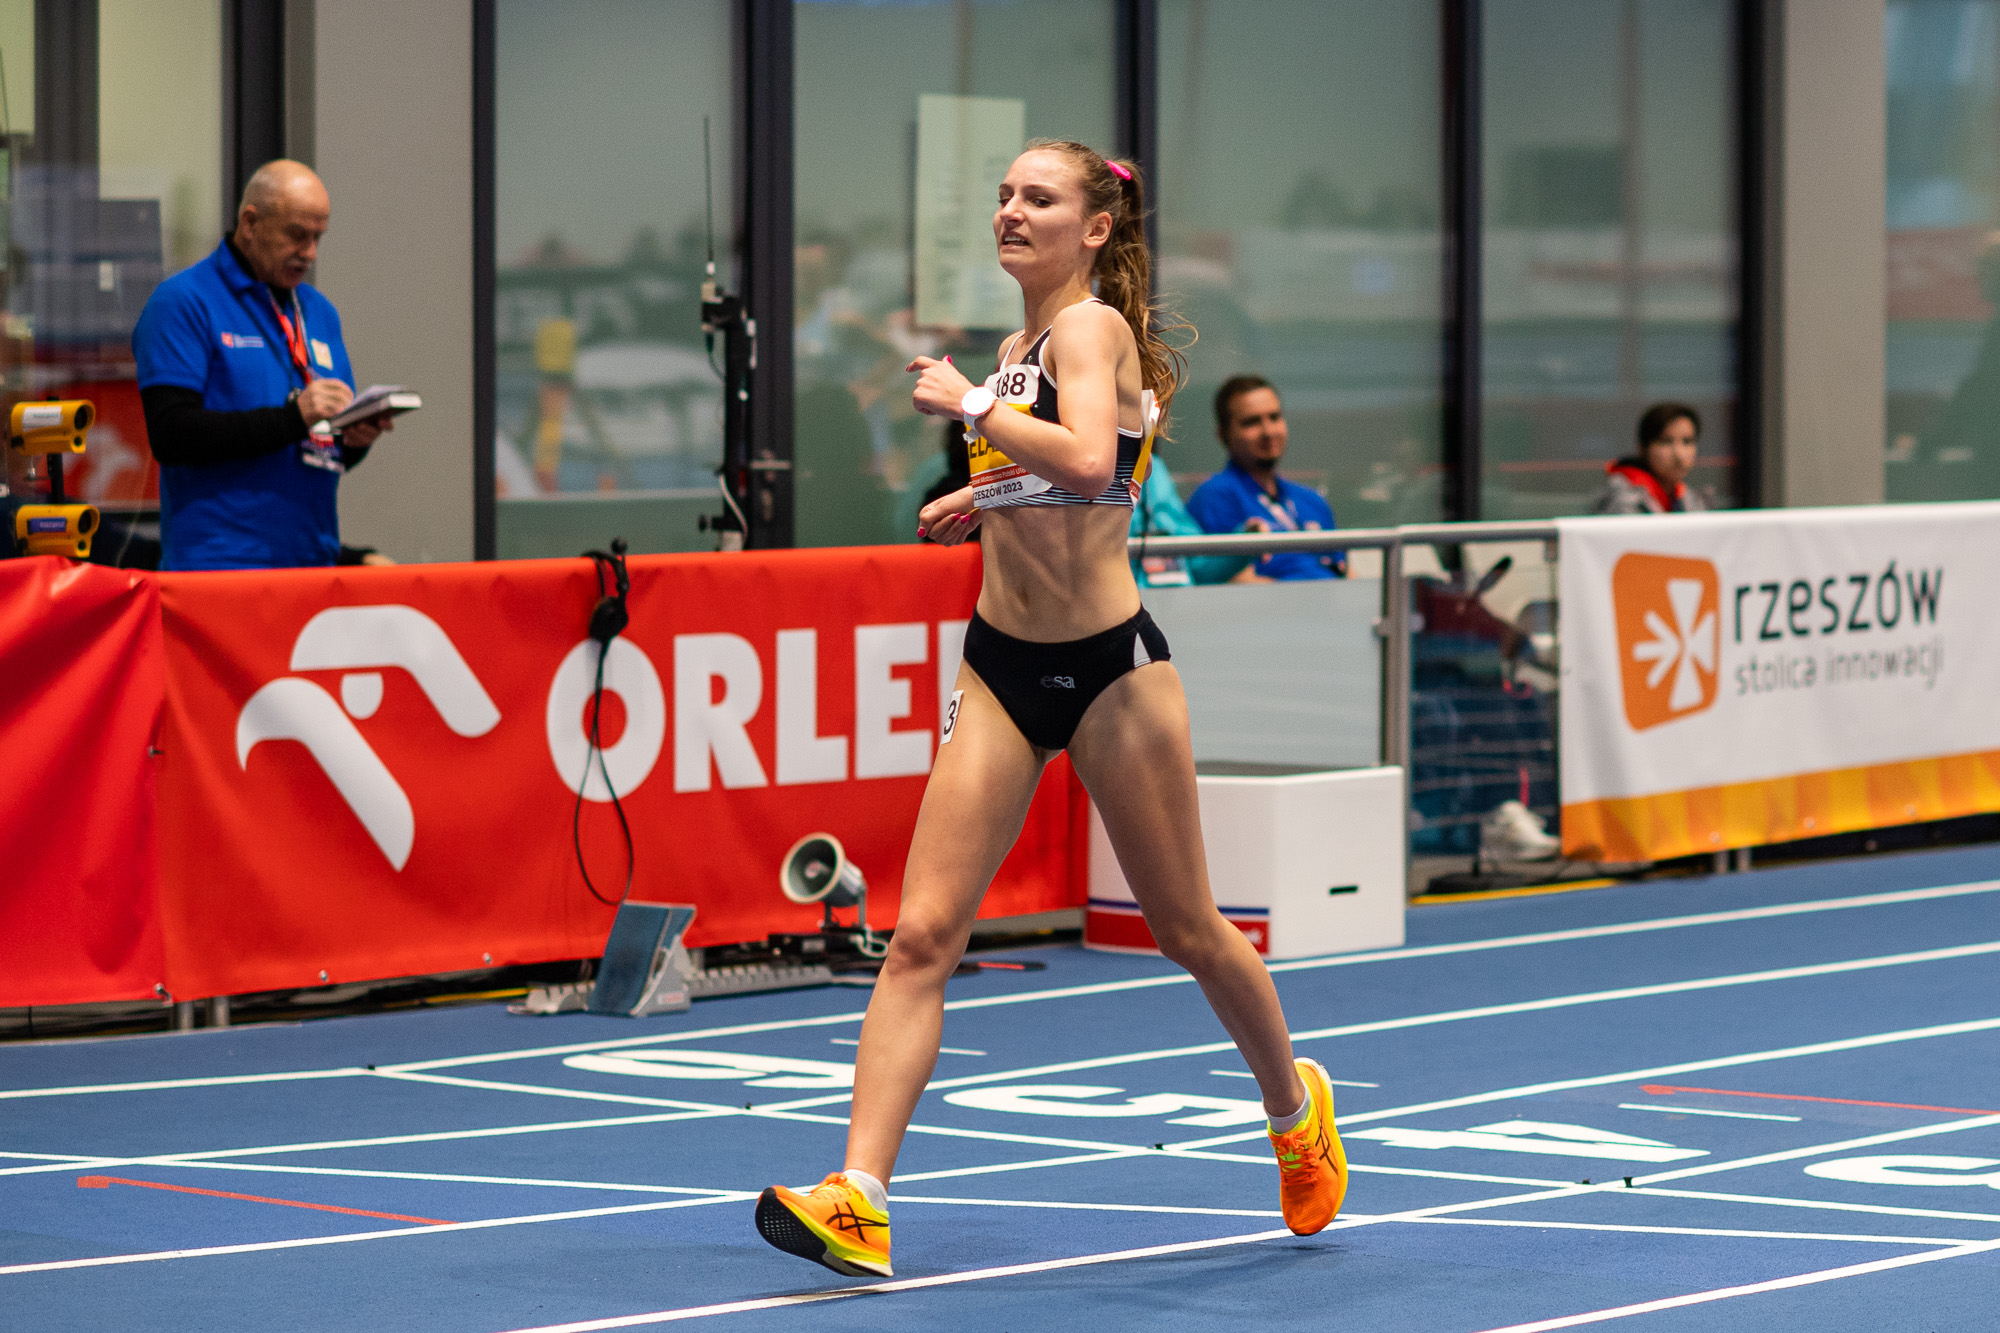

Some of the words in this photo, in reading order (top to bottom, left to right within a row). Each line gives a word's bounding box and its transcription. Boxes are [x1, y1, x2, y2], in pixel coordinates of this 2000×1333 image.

[995, 372, 1027, 398] 188
[973, 485, 1002, 501] ZESZÓW
[1002, 481, 1023, 494] 2023
[1734, 559, 1943, 643] rzeszów
[1735, 652, 1817, 696] stolica
[1825, 636, 1943, 690] innowacji
[943, 699, 957, 736] 3
[1340, 1119, 1711, 1164] 4
